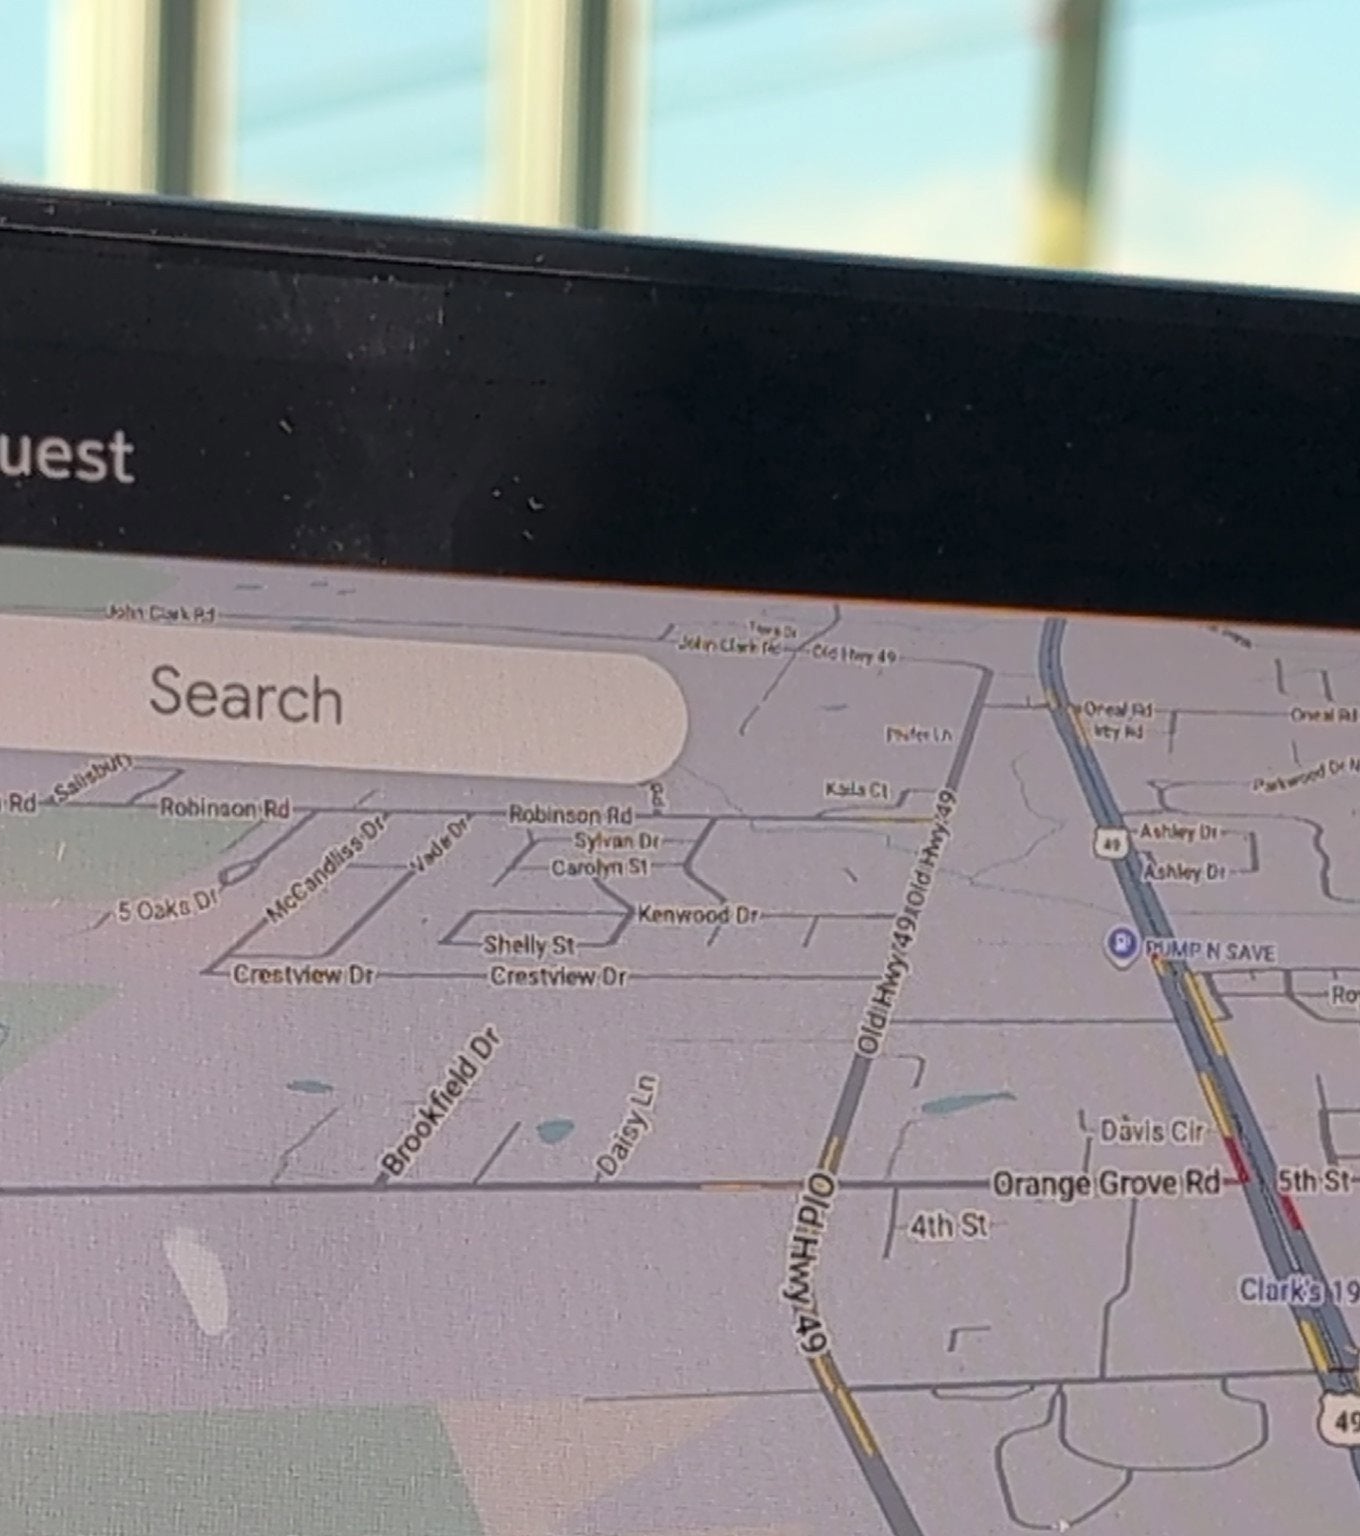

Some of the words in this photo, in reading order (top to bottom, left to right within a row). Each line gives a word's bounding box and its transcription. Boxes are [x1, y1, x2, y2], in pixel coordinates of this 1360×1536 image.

[149, 663, 343, 726] Search
[9, 793, 37, 813] Rd
[160, 797, 256, 819] Robinson
[264, 799, 289, 820] Rd
[509, 804, 601, 825] Robinson
[607, 806, 633, 825] Rd
[447, 816, 470, 839] Dr
[1140, 823, 1195, 842] Ashley
[1200, 824, 1217, 840] Dr
[574, 831, 633, 853] Sylvan
[639, 833, 660, 849] Dr
[906, 869, 932, 905] Old
[920, 825, 951, 868] Hwy
[936, 789, 958, 819] 49
[266, 840, 357, 924] McCandliss
[360, 814, 387, 842] Dr
[551, 858, 623, 880] Carolyn
[628, 856, 649, 875] St
[1143, 862, 1202, 882] Ashley
[1207, 863, 1226, 880] Dr
[118, 902, 131, 922] 5
[138, 899, 190, 921] Oaks
[193, 889, 220, 912] Dr
[639, 905, 732, 925] Kenwood
[736, 906, 759, 925] Dr
[483, 935, 547, 960] Shelly
[552, 936, 575, 954] St
[1146, 940, 1202, 958] PUMP
[1206, 943, 1222, 960] N
[1226, 943, 1277, 963] SAVE
[233, 964, 342, 985] Crestview
[349, 965, 375, 985] Dr
[490, 966, 596, 986] Crestview
[602, 967, 628, 986] Dr
[857, 1010, 888, 1051] Old
[873, 952, 910, 1007] Hwy
[895, 916, 916, 948] 49
[381, 1056, 478, 1177] Brookfield
[470, 1027, 502, 1060] Dr
[596, 1110, 650, 1177] Daisy
[631, 1075, 656, 1107] Ln
[1101, 1120, 1166, 1143] Davis
[1171, 1121, 1205, 1143] Cir
[993, 1170, 1092, 1201] Orange
[1099, 1170, 1177, 1196] Grove
[1186, 1169, 1221, 1195] Rd
[1277, 1171, 1319, 1193] 5th
[1323, 1171, 1350, 1192] St
[797, 1172, 835, 1231] Old
[910, 1213, 953, 1239] 4th
[960, 1213, 988, 1237] St
[783, 1234, 818, 1303] Hwy
[1240, 1277, 1322, 1302] Clark's
[795, 1315, 827, 1353] 49
